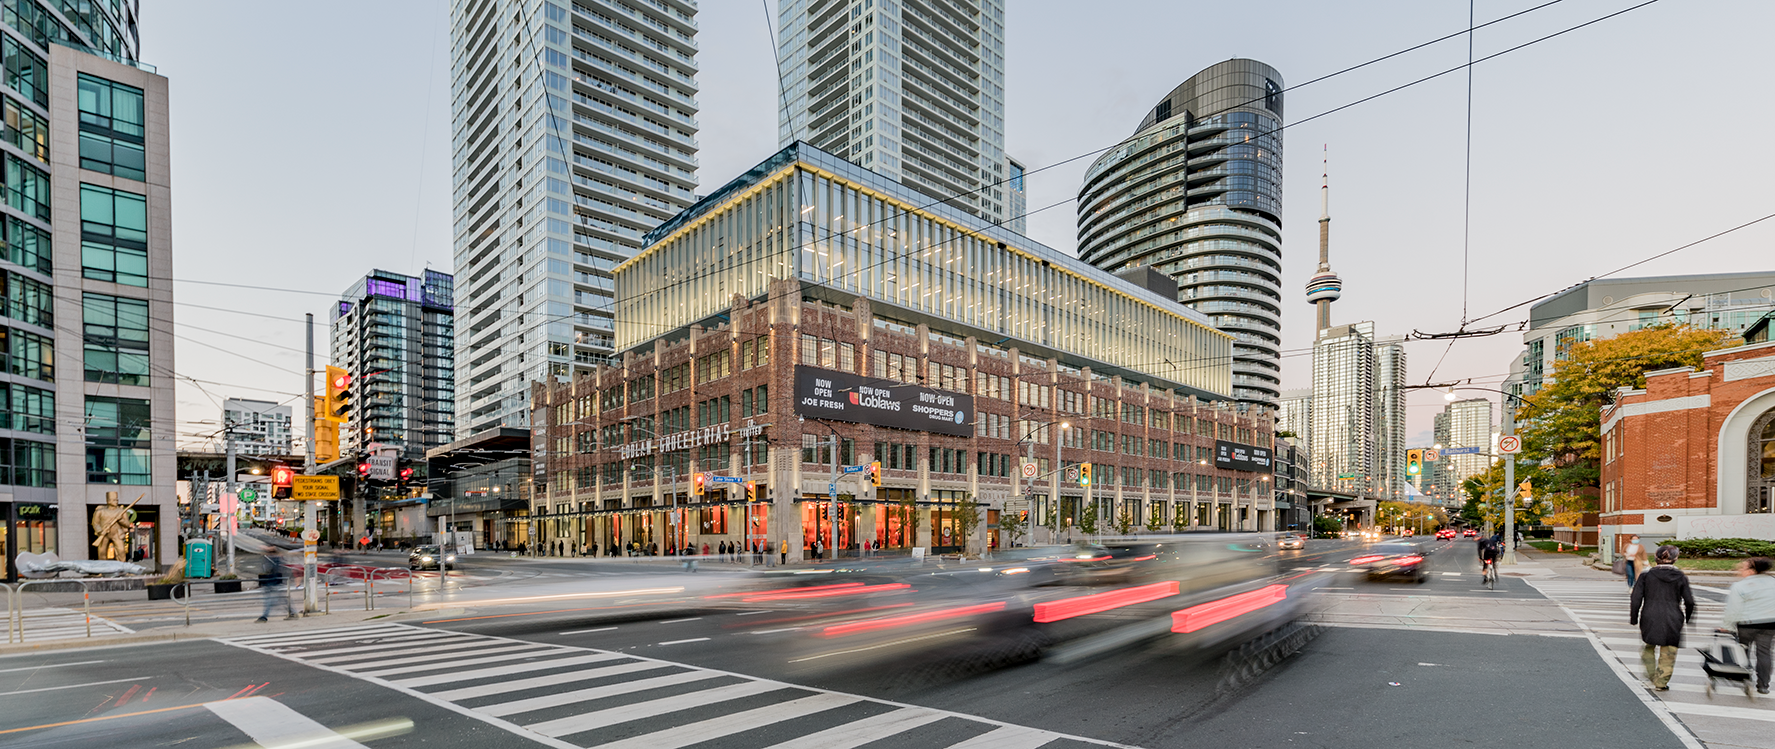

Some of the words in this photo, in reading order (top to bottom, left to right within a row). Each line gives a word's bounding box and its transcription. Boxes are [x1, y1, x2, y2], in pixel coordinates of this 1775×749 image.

[815, 378, 832, 389] NOW
[814, 387, 833, 398] OPEN
[859, 385, 874, 396] NOW
[874, 388, 891, 398] OPEN
[801, 397, 818, 407] JOE
[819, 399, 845, 410] FRESH
[859, 393, 901, 412] Loblaws
[919, 392, 936, 404] NOW
[937, 395, 955, 407] OPEN
[912, 404, 955, 418] SHOPPERS
[659, 423, 730, 453] GROCETERIAS
[368, 458, 392, 467] TRANSIT
[369, 468, 390, 476] SIGNAL
